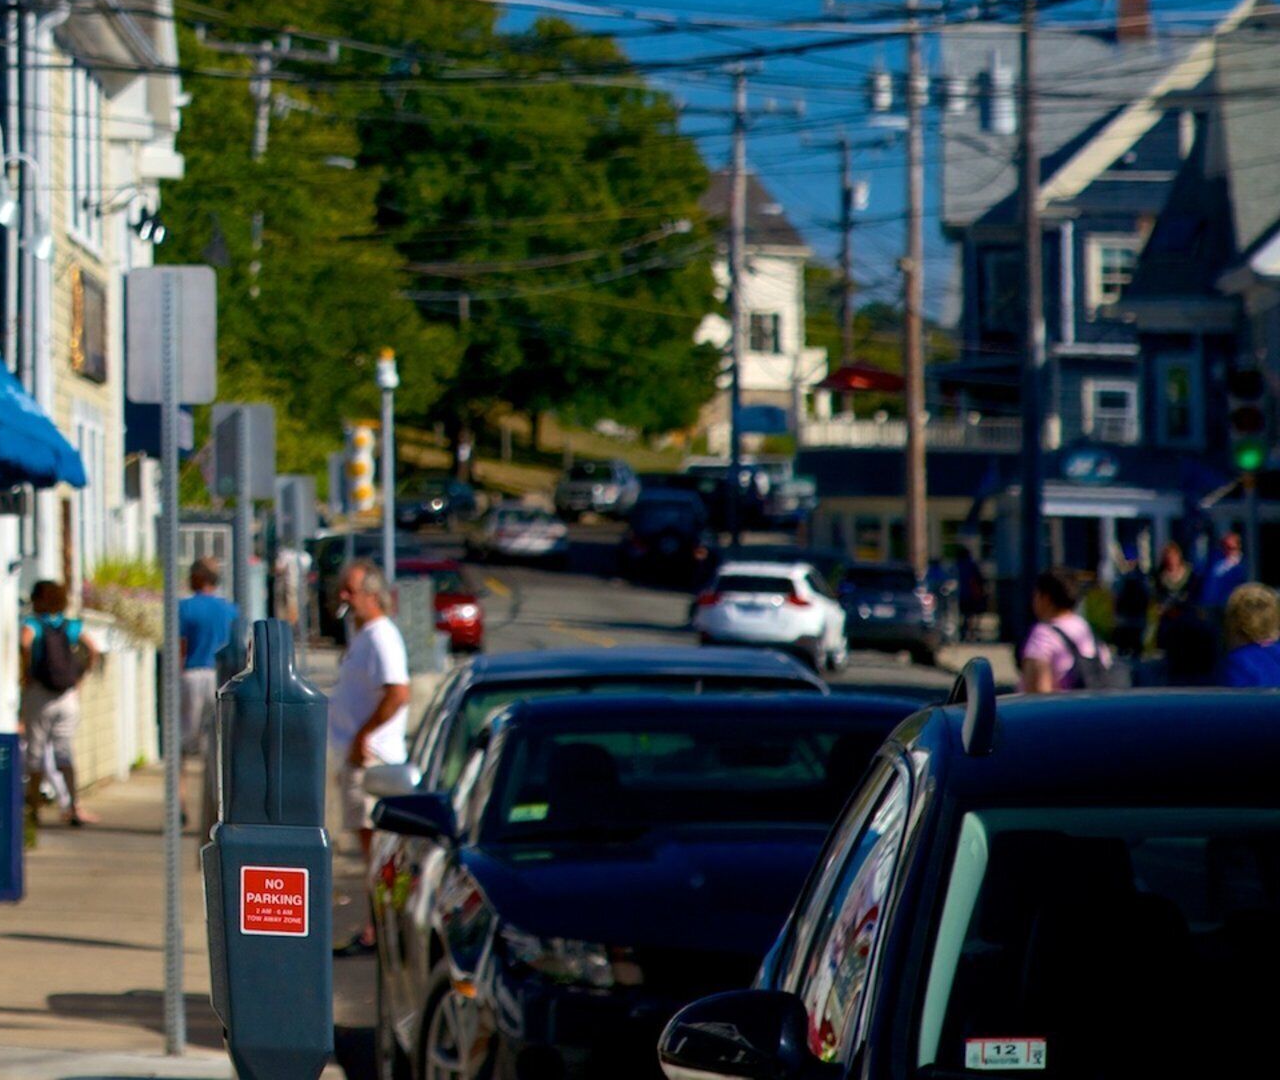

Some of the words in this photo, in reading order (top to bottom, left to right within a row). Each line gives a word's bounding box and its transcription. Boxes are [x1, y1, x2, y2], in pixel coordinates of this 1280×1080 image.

[264, 878, 284, 890] NO
[246, 892, 302, 906] PARKING
[283, 916, 302, 925] ZONE
[993, 1044, 1017, 1056] 12
